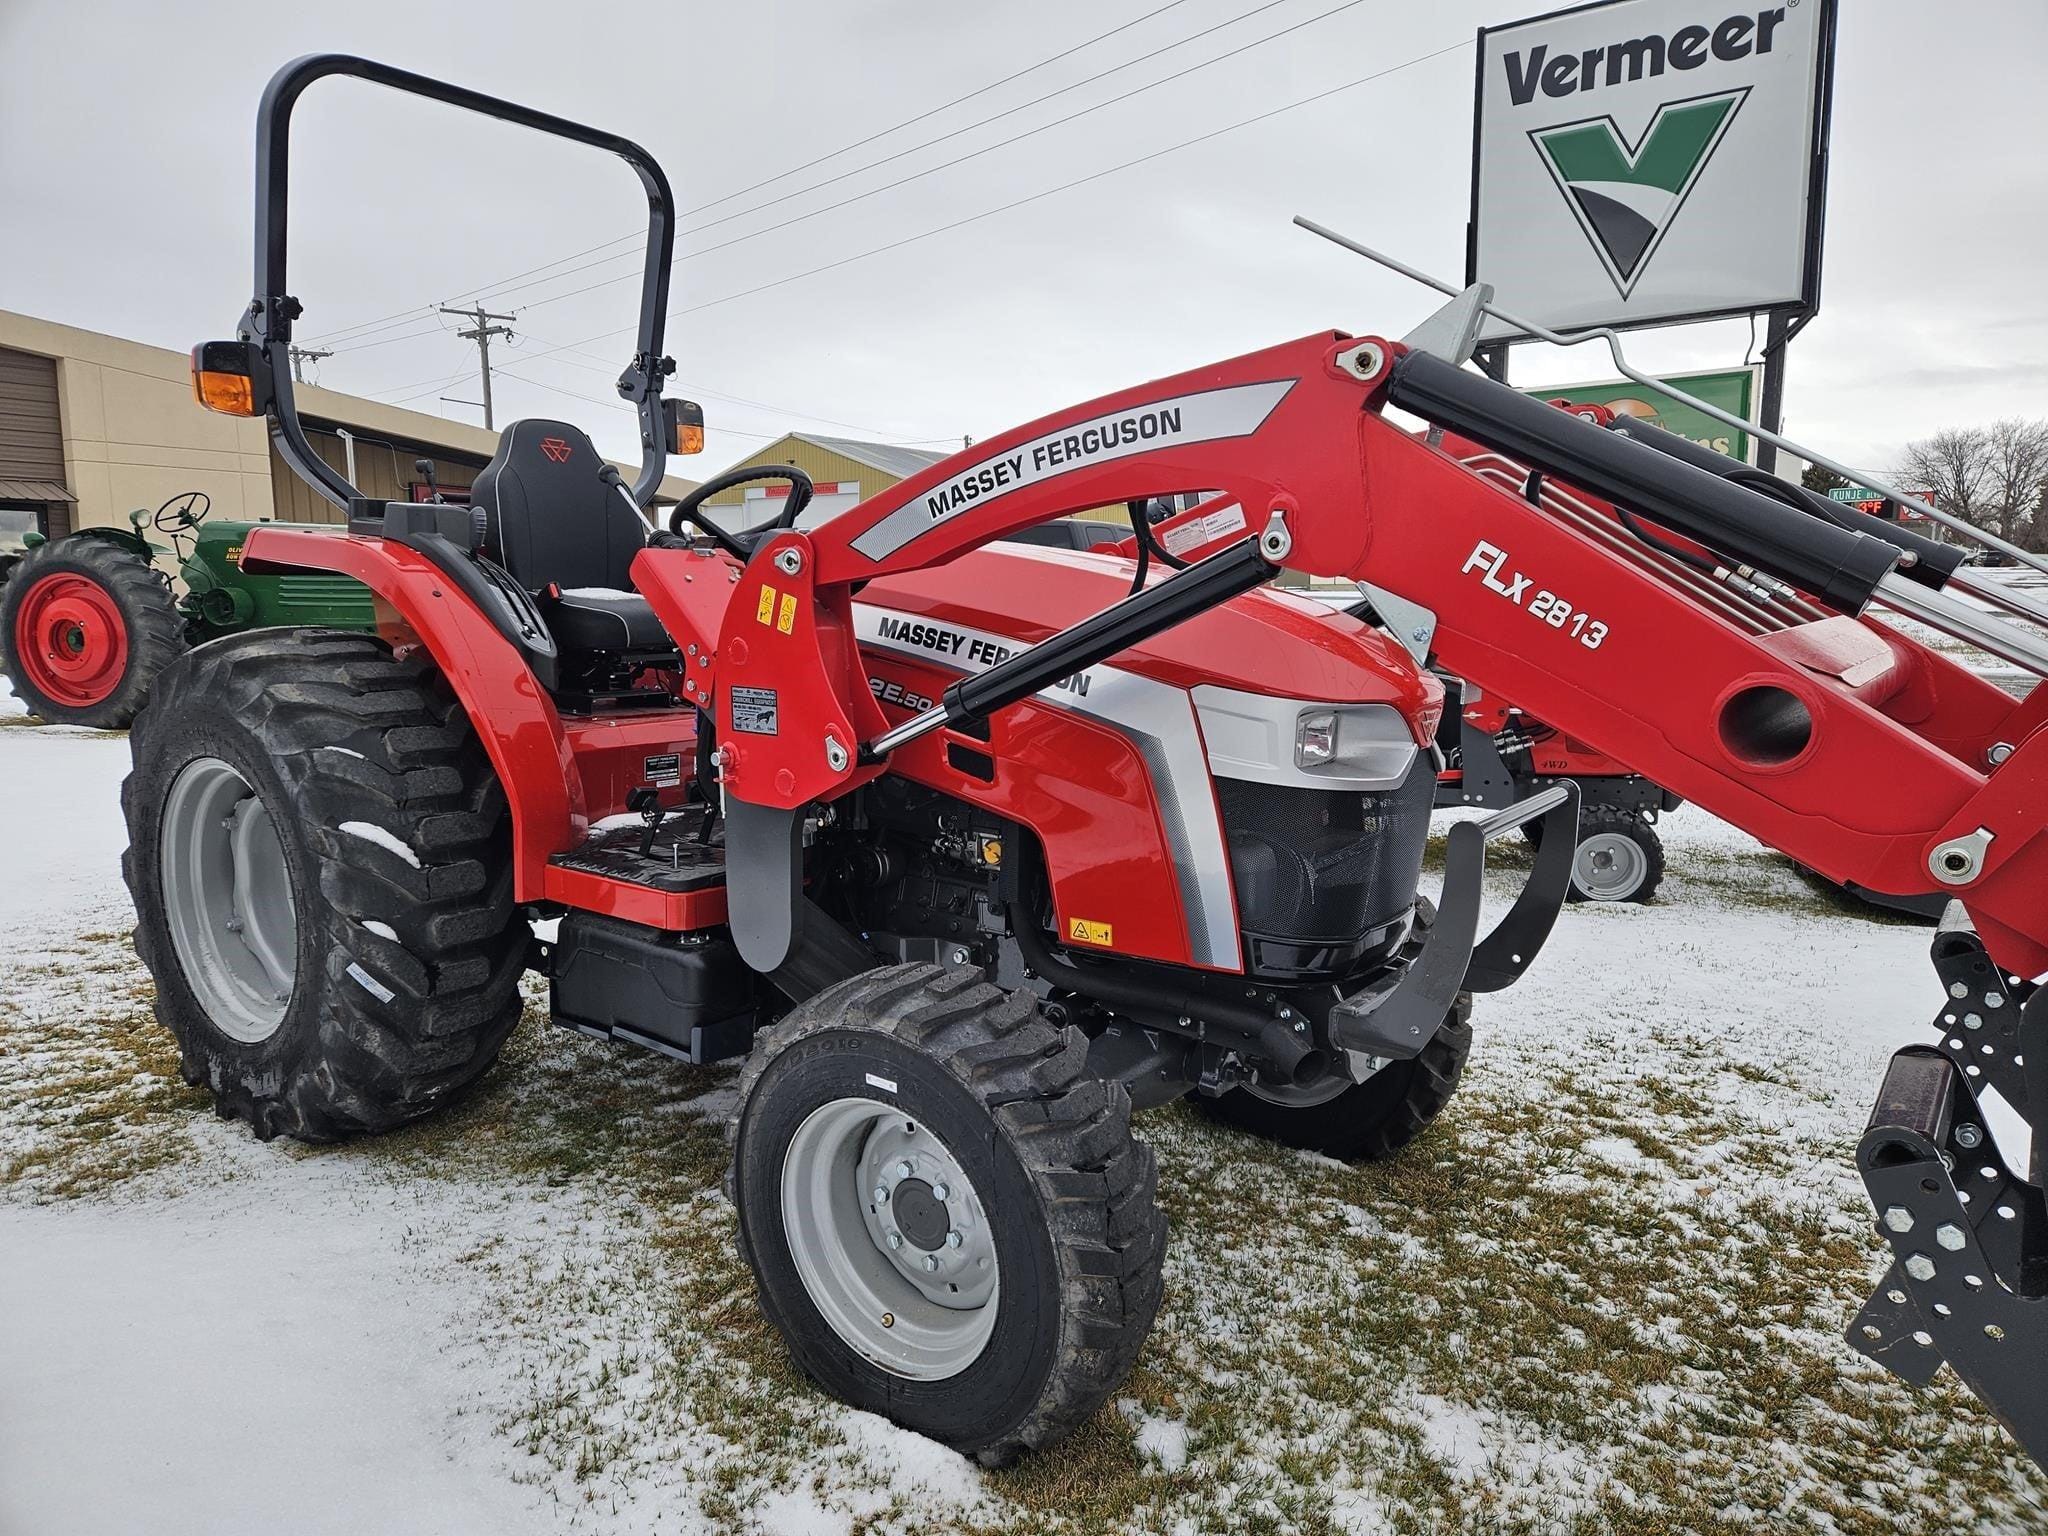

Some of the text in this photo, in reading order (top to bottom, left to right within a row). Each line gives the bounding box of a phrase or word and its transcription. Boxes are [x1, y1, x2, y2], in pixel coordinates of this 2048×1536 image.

[1503, 7, 1785, 106] Vermeer
[927, 407, 1182, 519] MASSEY FERGUSON
[1833, 490, 1862, 501] KUNJE
[878, 617, 967, 655] MASSEY
[1527, 589, 1610, 650] 2813
[1541, 760, 1568, 769] 4WD
